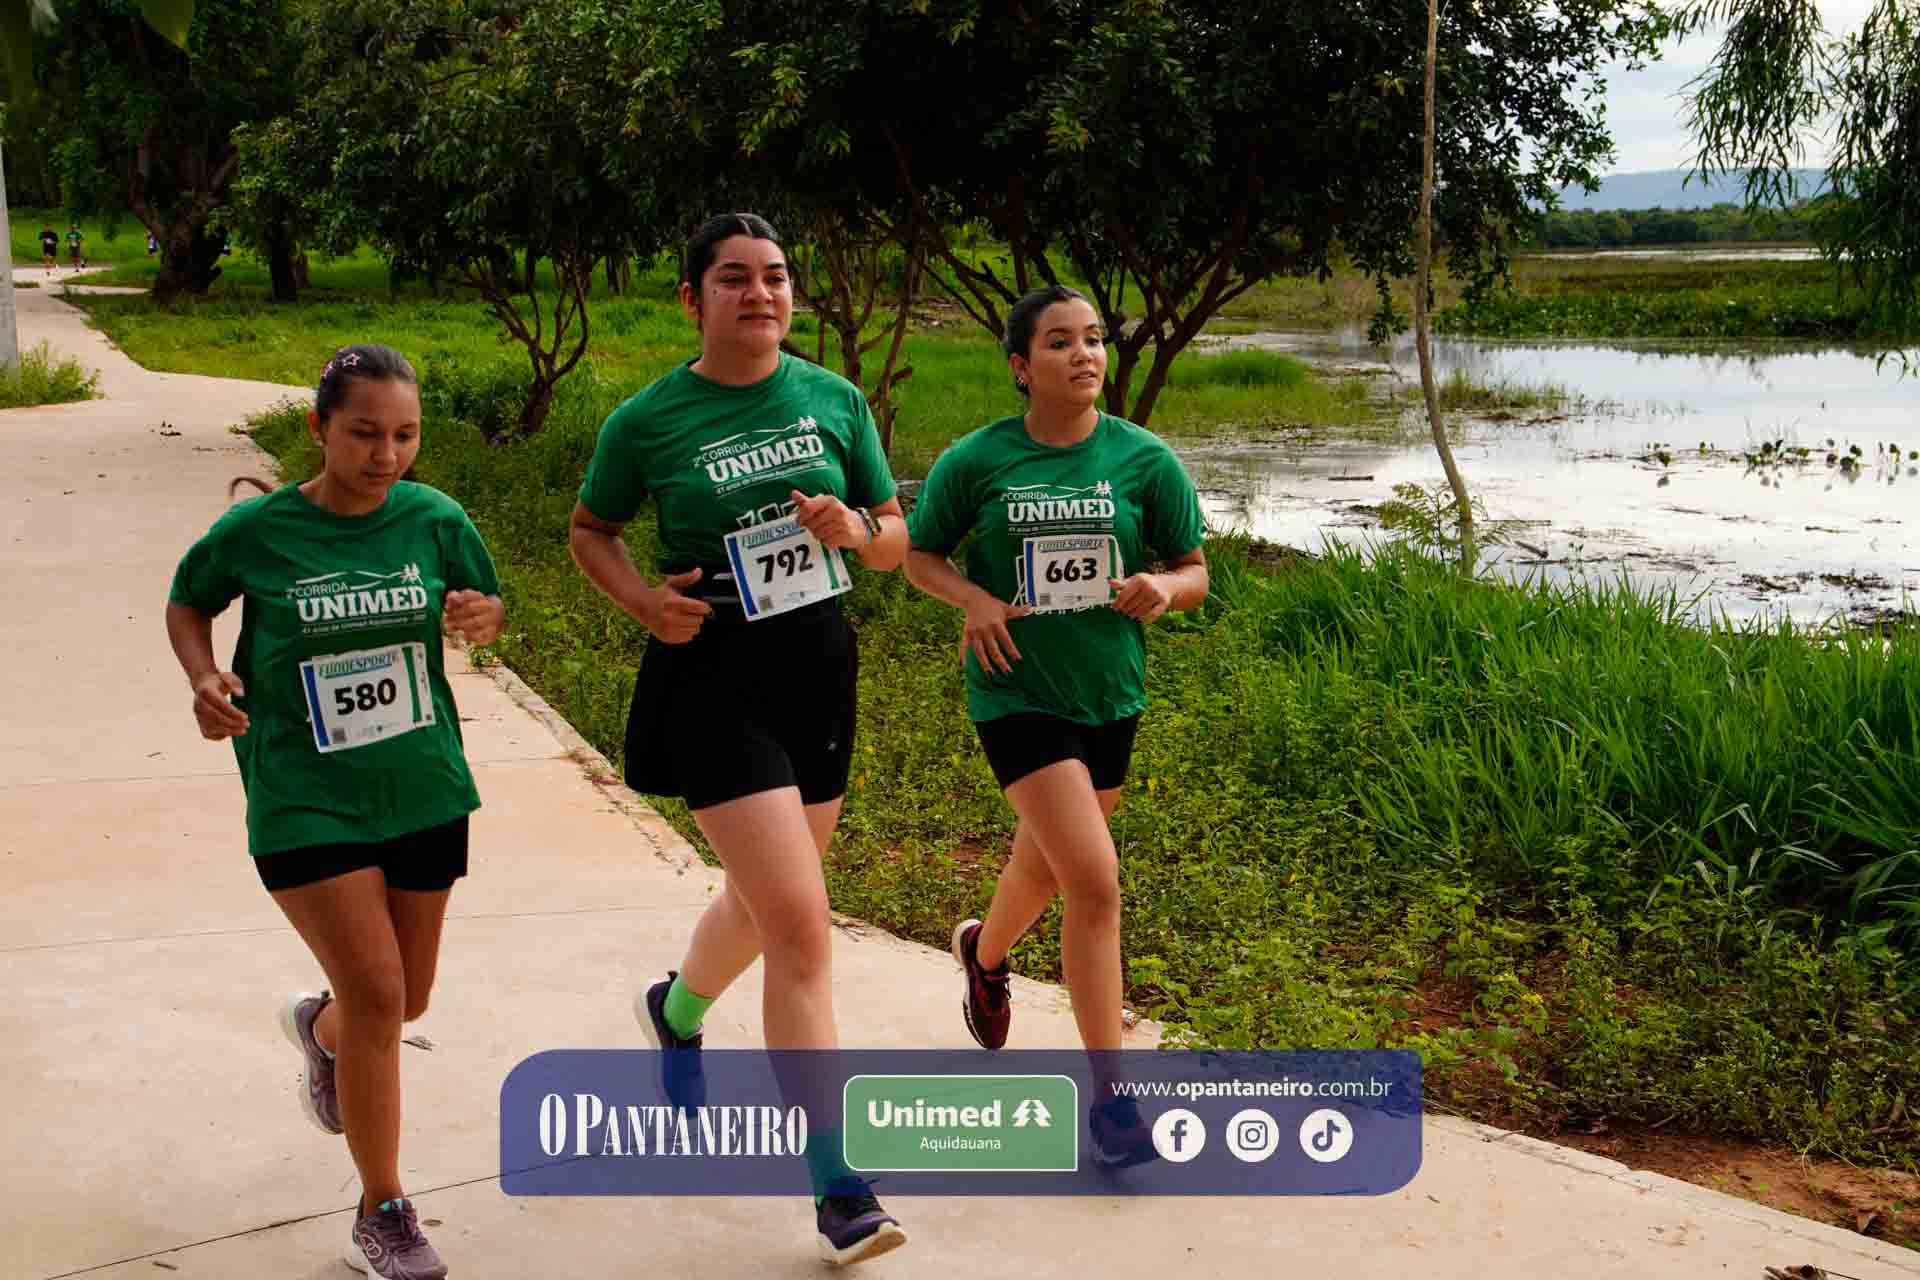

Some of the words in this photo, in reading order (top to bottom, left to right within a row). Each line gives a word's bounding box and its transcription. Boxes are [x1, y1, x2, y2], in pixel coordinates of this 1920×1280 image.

[703, 442, 751, 463] CORRIDA
[705, 434, 824, 482] UNIMED
[1008, 491, 1049, 501] CORRIDA
[1008, 499, 1116, 523] UNIMED
[756, 544, 814, 584] 792
[1046, 558, 1097, 584] 663
[296, 581, 349, 598] CORRIDA
[297, 586, 427, 623] UNIMED
[334, 678, 397, 716] 580
